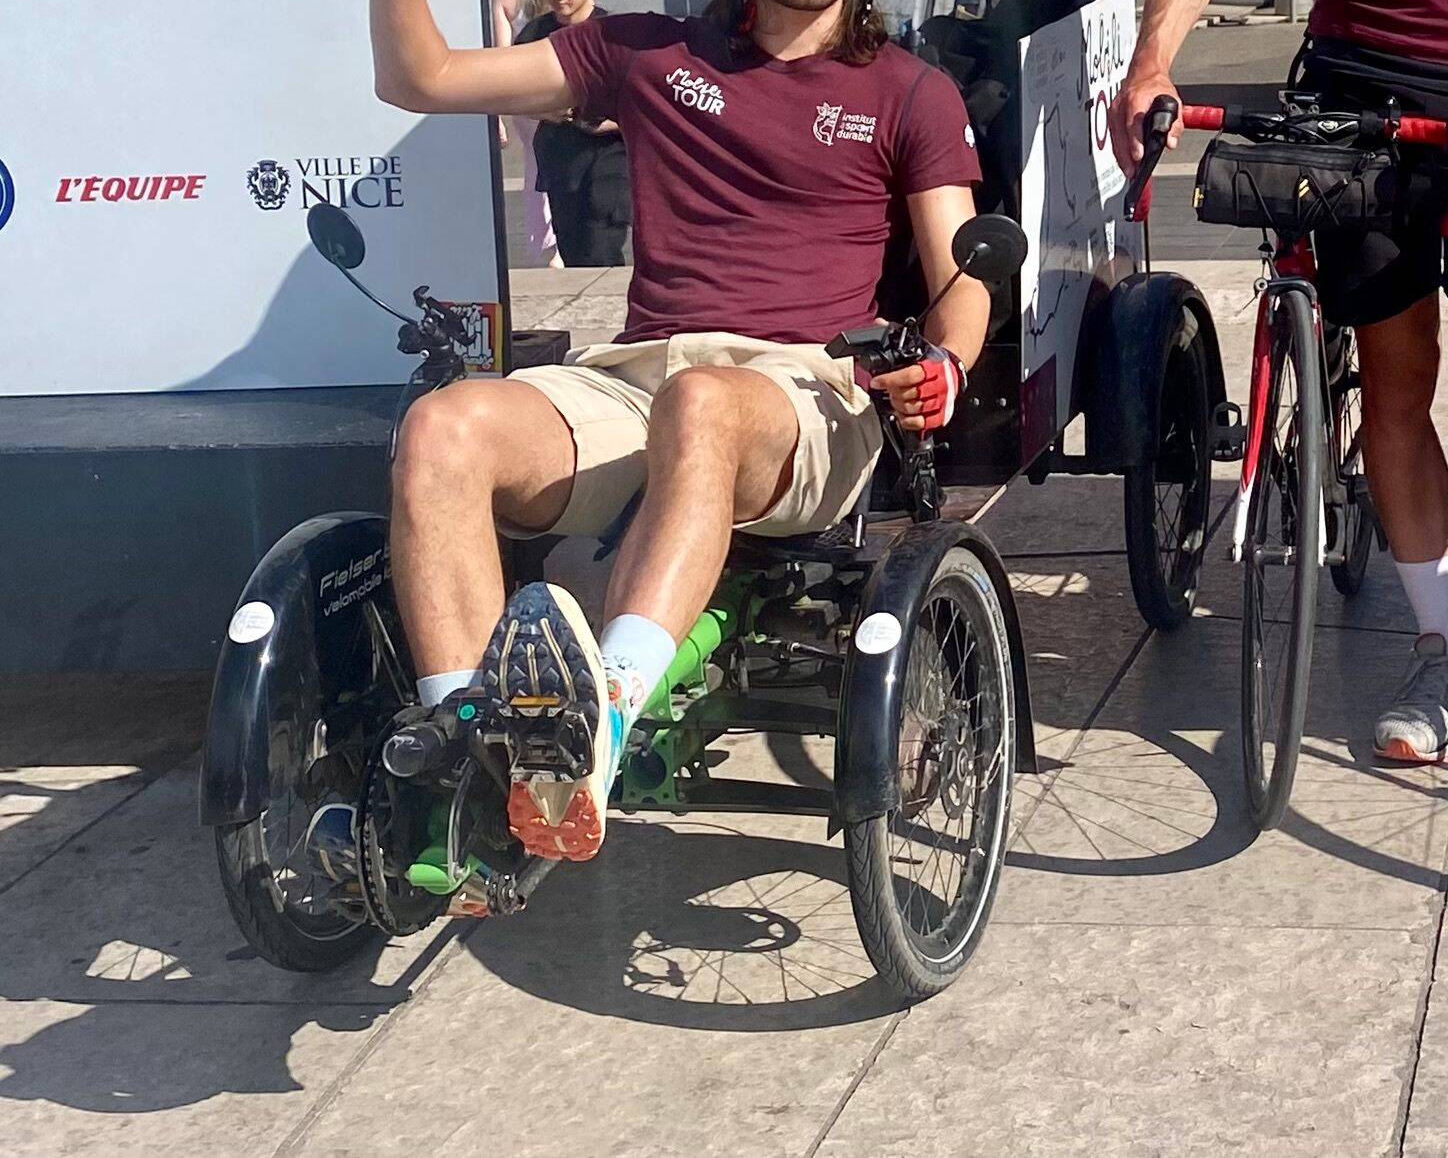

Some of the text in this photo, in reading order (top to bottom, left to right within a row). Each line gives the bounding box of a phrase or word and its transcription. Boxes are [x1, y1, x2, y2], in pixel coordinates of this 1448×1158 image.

[672, 84, 726, 116] TOUR
[295, 155, 402, 178] VILLE DE
[55, 173, 207, 203] L'ÉQUIPE
[300, 176, 404, 210] NICE
[323, 574, 382, 617] velomobile
